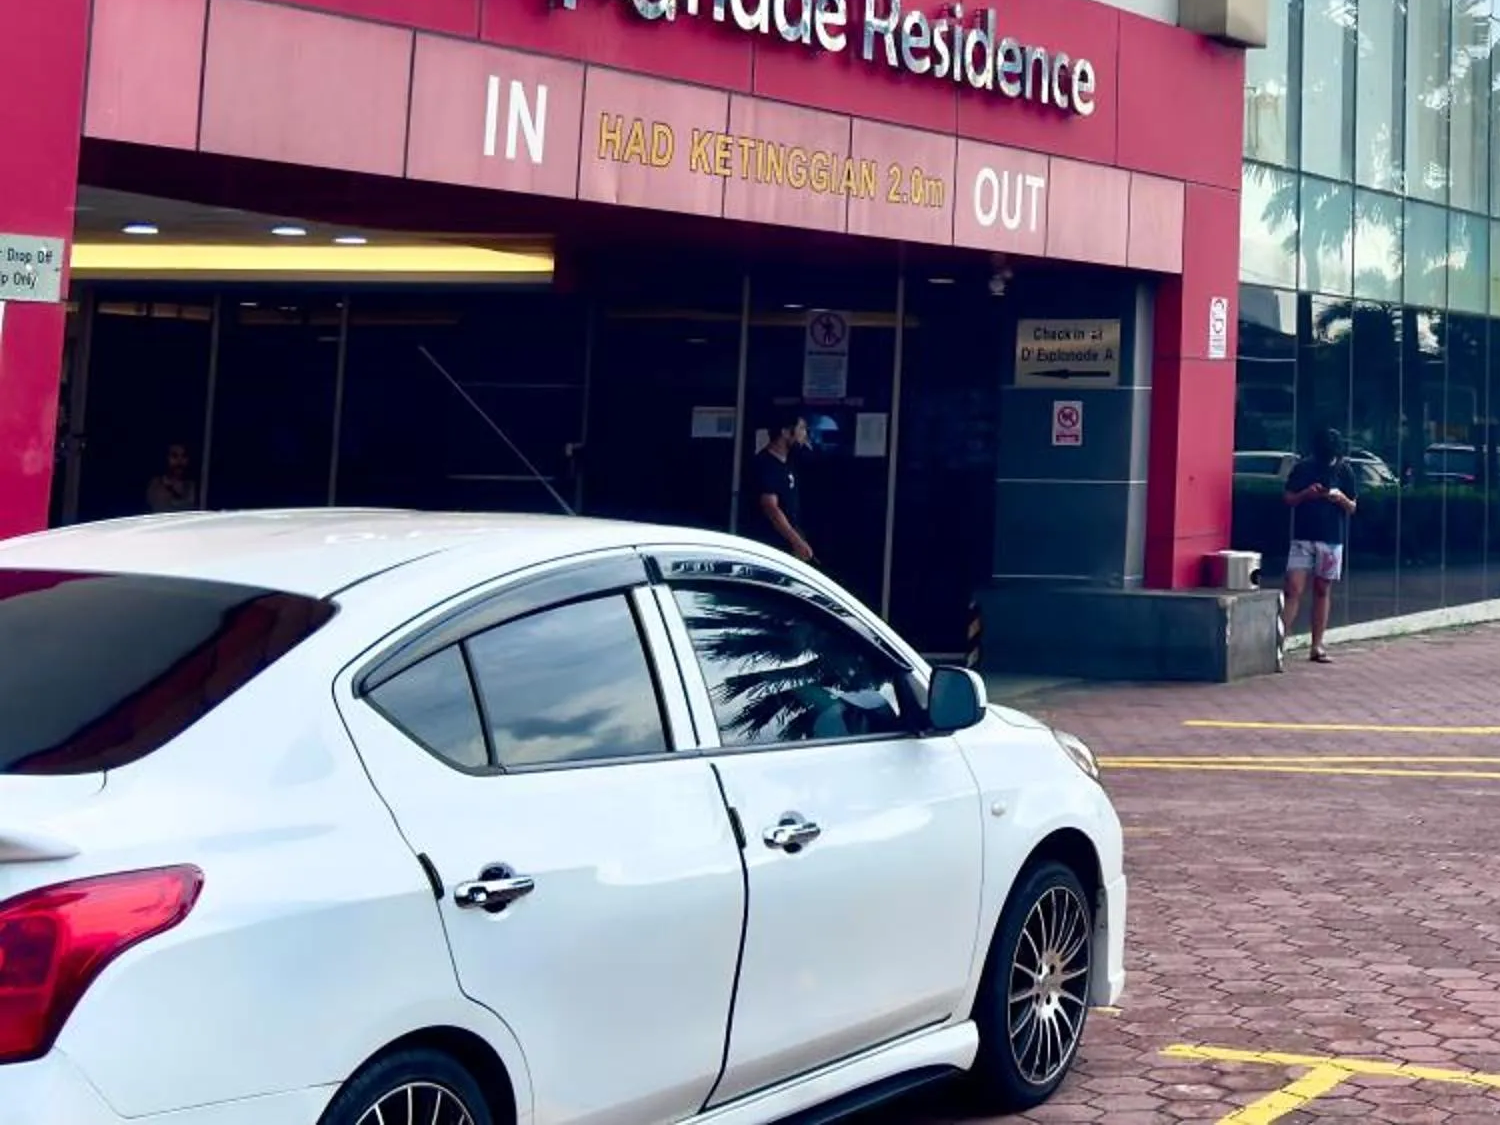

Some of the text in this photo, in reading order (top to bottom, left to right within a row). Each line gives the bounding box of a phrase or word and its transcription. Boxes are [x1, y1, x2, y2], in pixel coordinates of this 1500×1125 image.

[483, 75, 548, 164] IN
[598, 112, 944, 208] HAD KETINGGIAN 2.0m
[973, 166, 1045, 231] OUT
